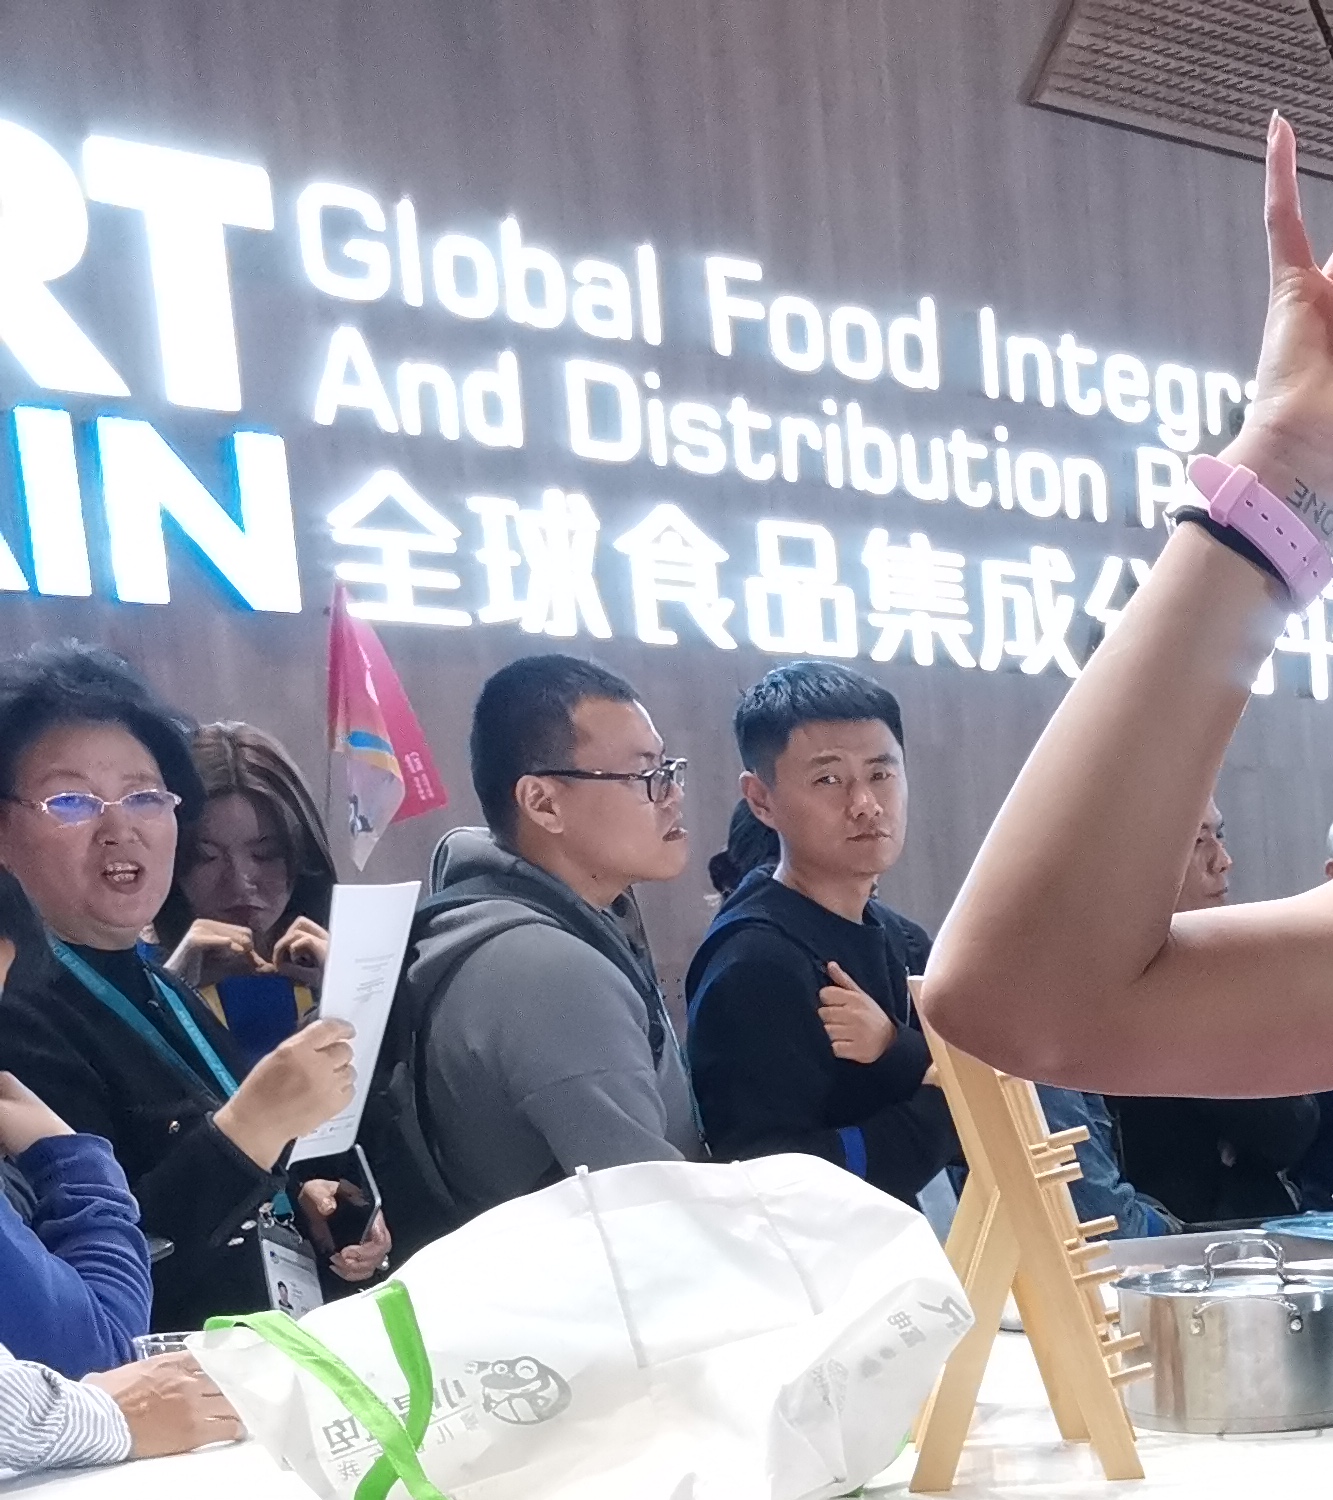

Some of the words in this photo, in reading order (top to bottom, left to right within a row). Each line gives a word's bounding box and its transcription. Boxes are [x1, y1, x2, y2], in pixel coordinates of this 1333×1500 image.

[296, 182, 663, 346] Global
[705, 256, 939, 391] Food
[979, 305, 1259, 452] Integr
[0, 404, 303, 614] IN
[313, 325, 525, 449] And
[566, 357, 1107, 523] Distribution
